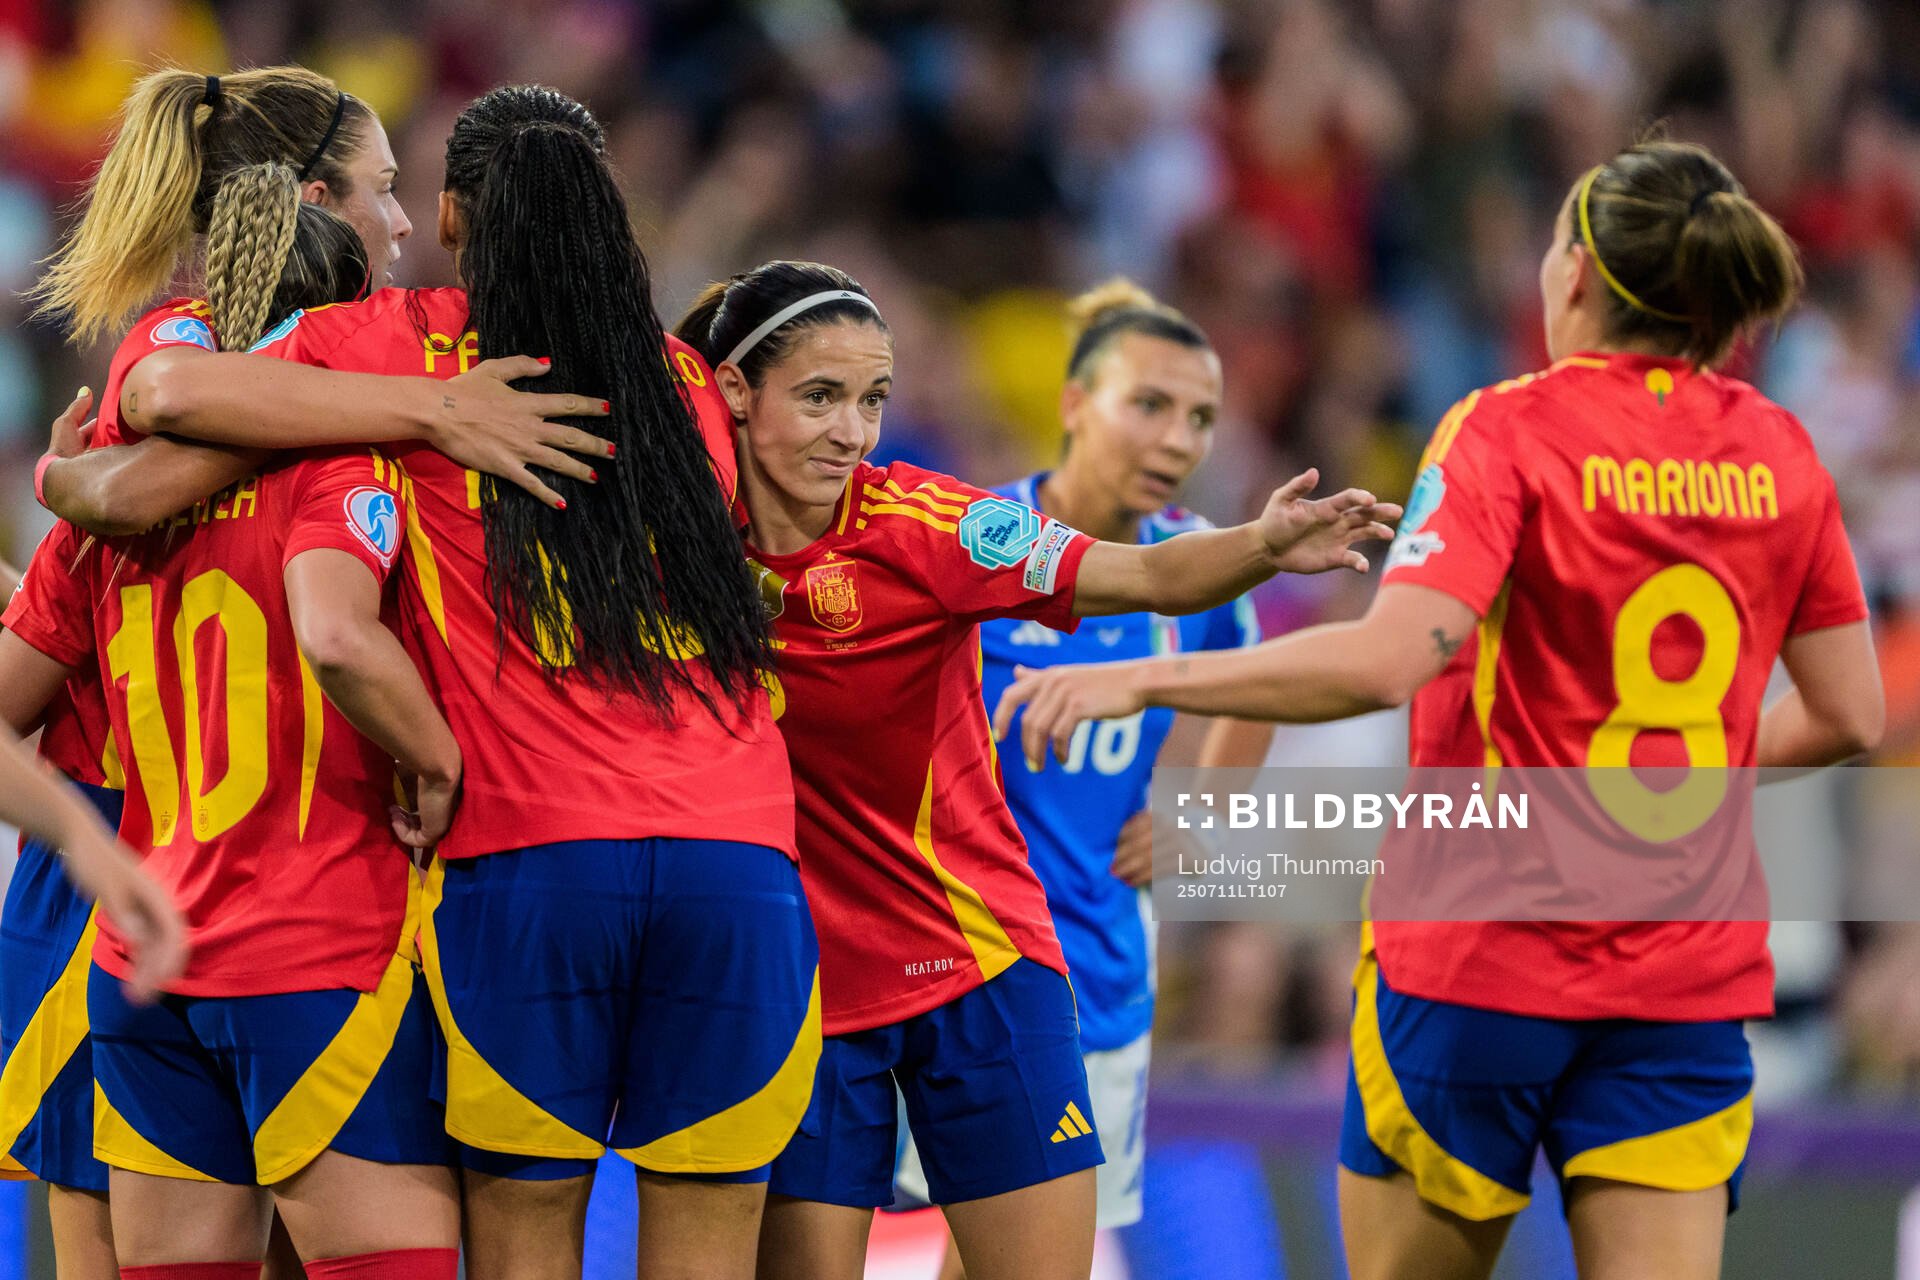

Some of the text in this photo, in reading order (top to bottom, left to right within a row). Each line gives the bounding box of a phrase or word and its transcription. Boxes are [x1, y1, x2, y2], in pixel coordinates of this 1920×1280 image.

[1582, 454, 1779, 519] MARIONA
[981, 526, 994, 539] We
[998, 519, 1020, 547] Strong
[1034, 529, 1062, 590] FOUNDATION
[106, 567, 268, 848] 10
[1586, 562, 1741, 844] 8
[904, 957, 954, 977] HEAT.RDY
